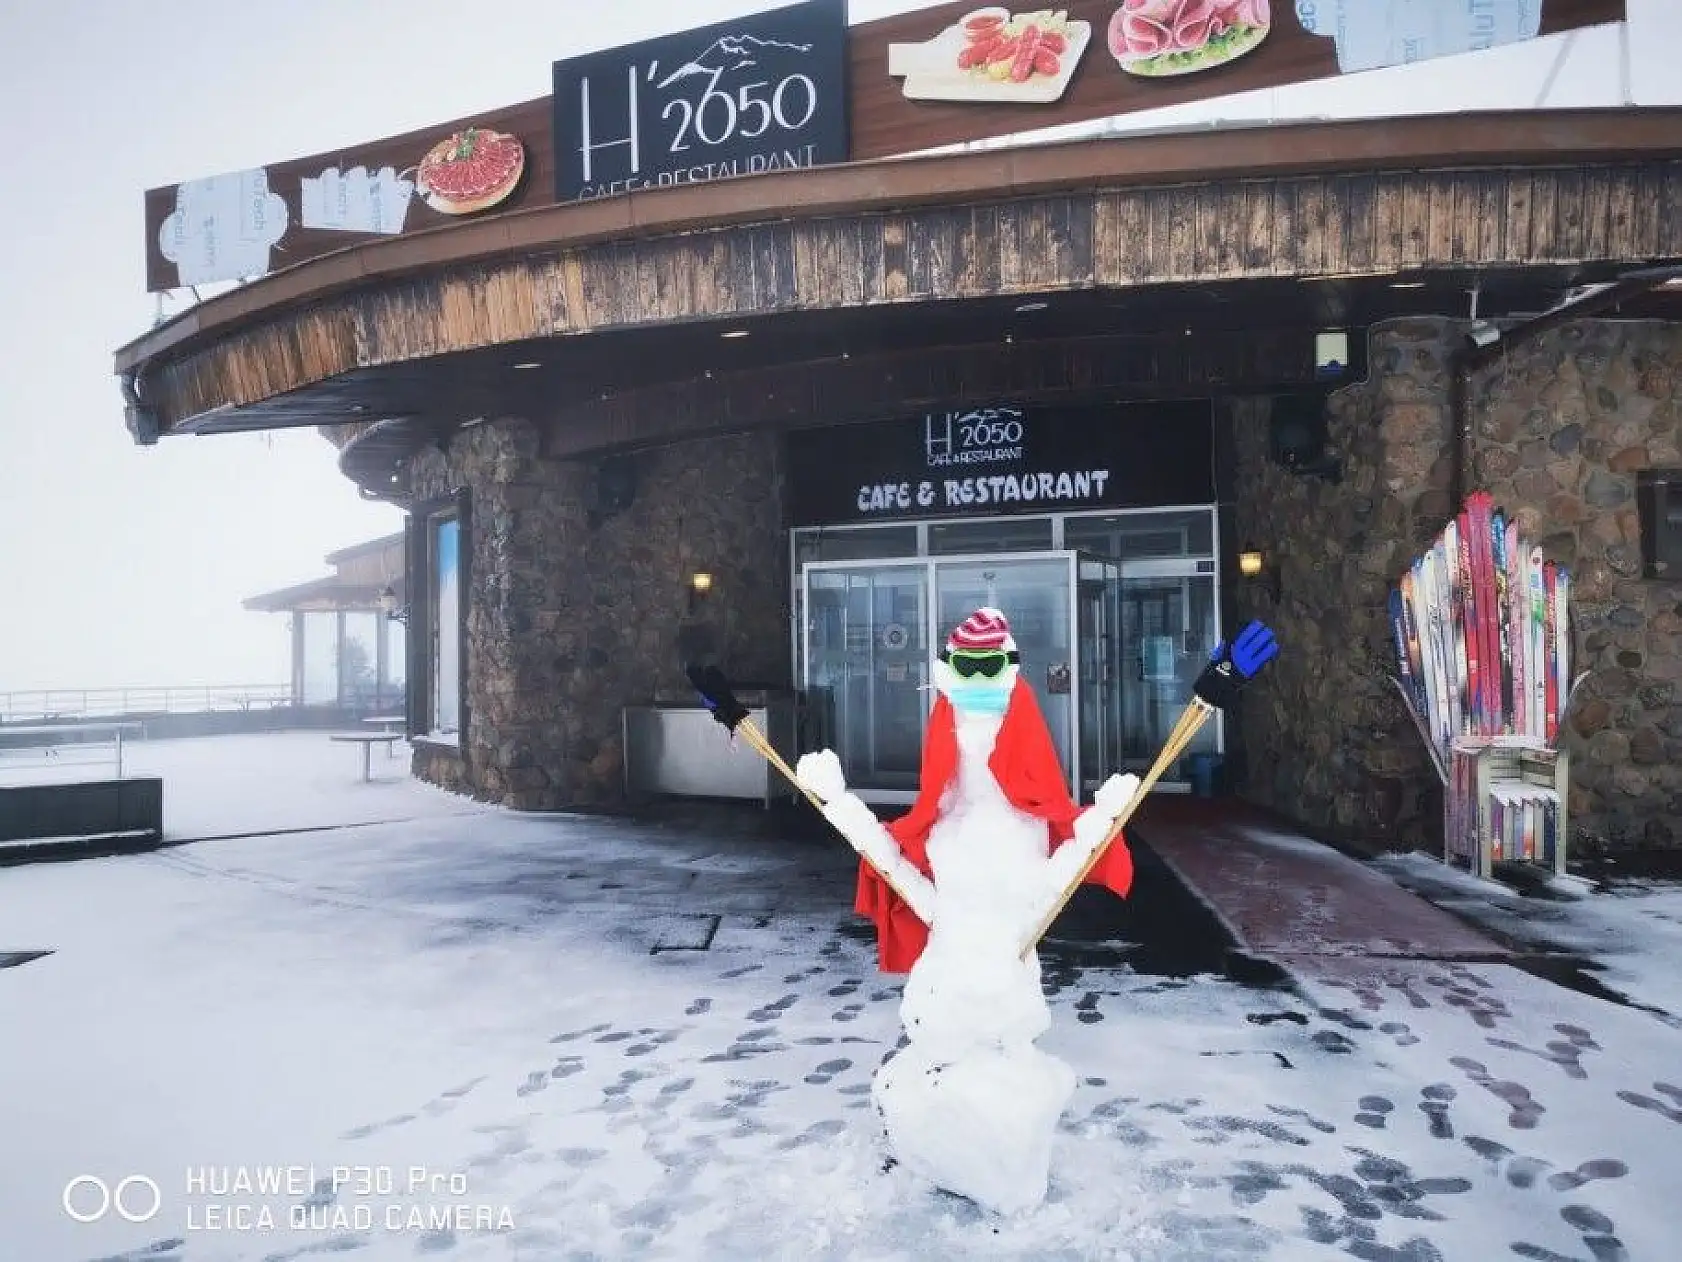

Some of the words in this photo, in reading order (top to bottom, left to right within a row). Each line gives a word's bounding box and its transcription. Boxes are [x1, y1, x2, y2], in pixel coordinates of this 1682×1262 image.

[661, 67, 818, 153] 2650
[960, 446, 1023, 463] RESTAURANT
[857, 482, 911, 512] CAFE
[917, 480, 936, 507] &
[943, 470, 1109, 508] RESTAURANT
